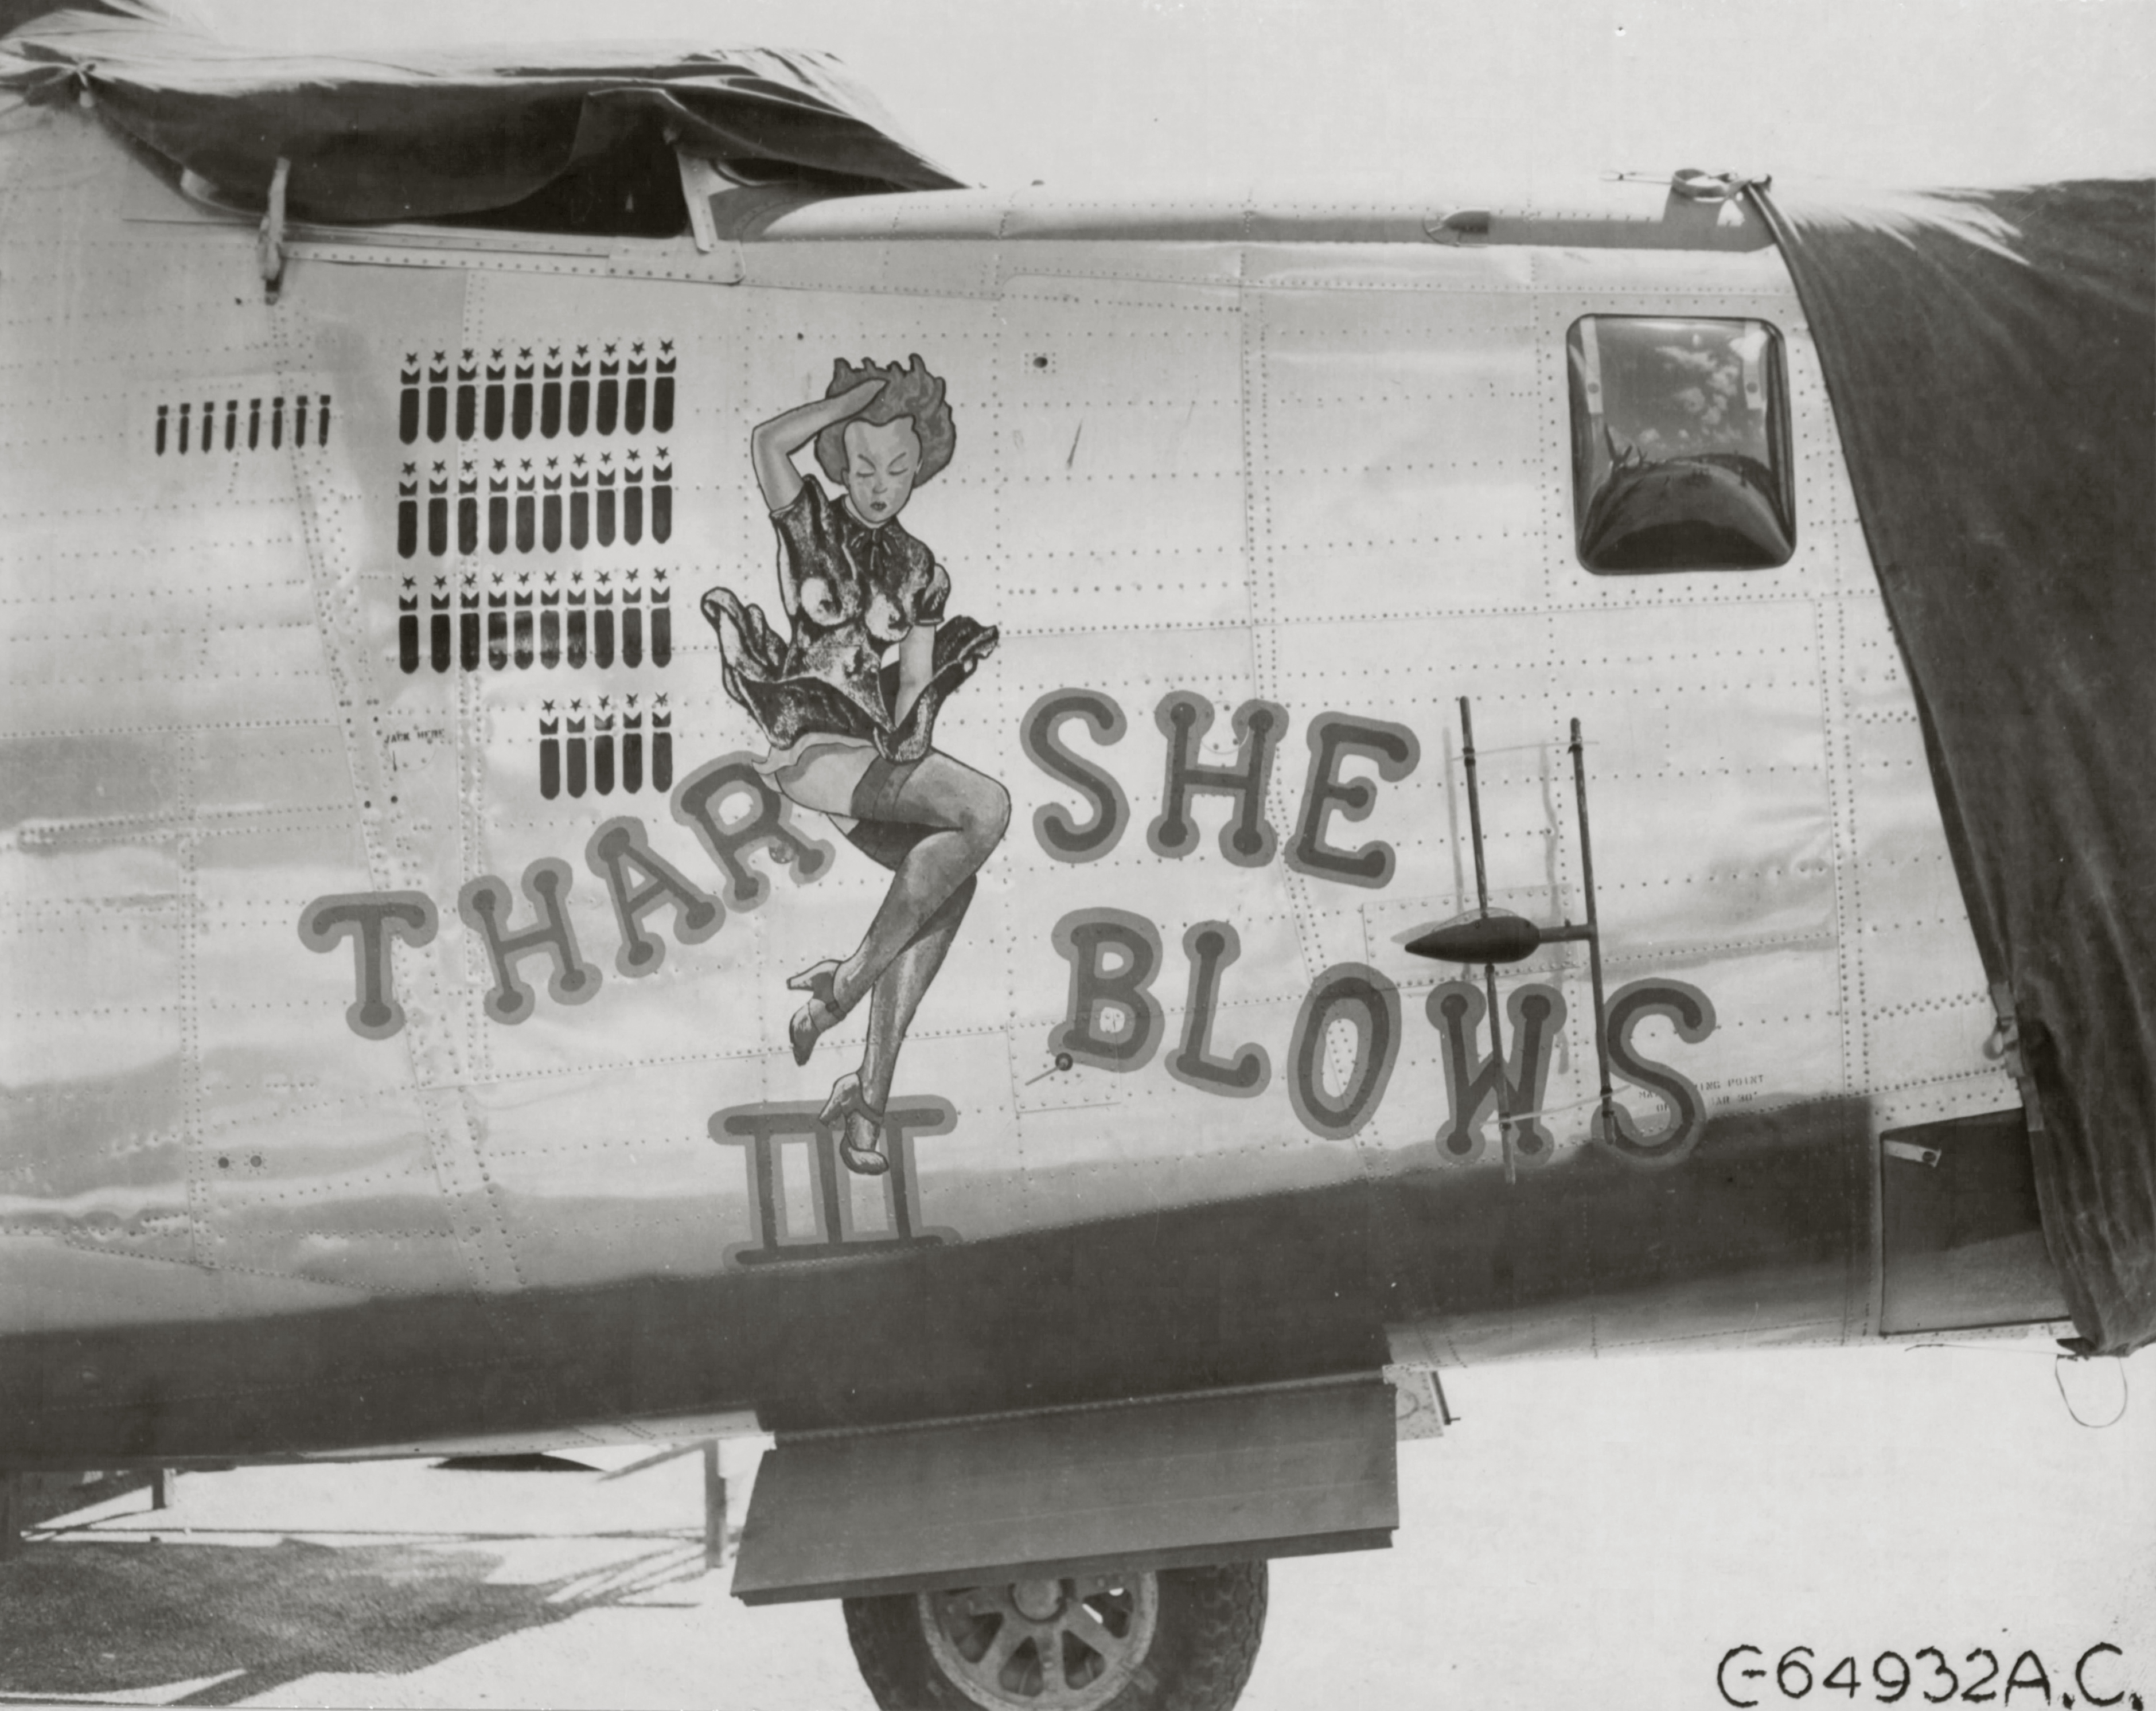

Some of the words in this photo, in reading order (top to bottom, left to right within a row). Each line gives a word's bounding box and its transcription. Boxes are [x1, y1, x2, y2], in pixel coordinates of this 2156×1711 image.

[384, 732, 411, 745] JACK
[417, 728, 445, 740] HERE
[298, 750, 835, 1041] THAR
[1019, 687, 1421, 889] SHE
[1047, 907, 1717, 1171] BLOWS
[1728, 1074, 1764, 1088] POINT
